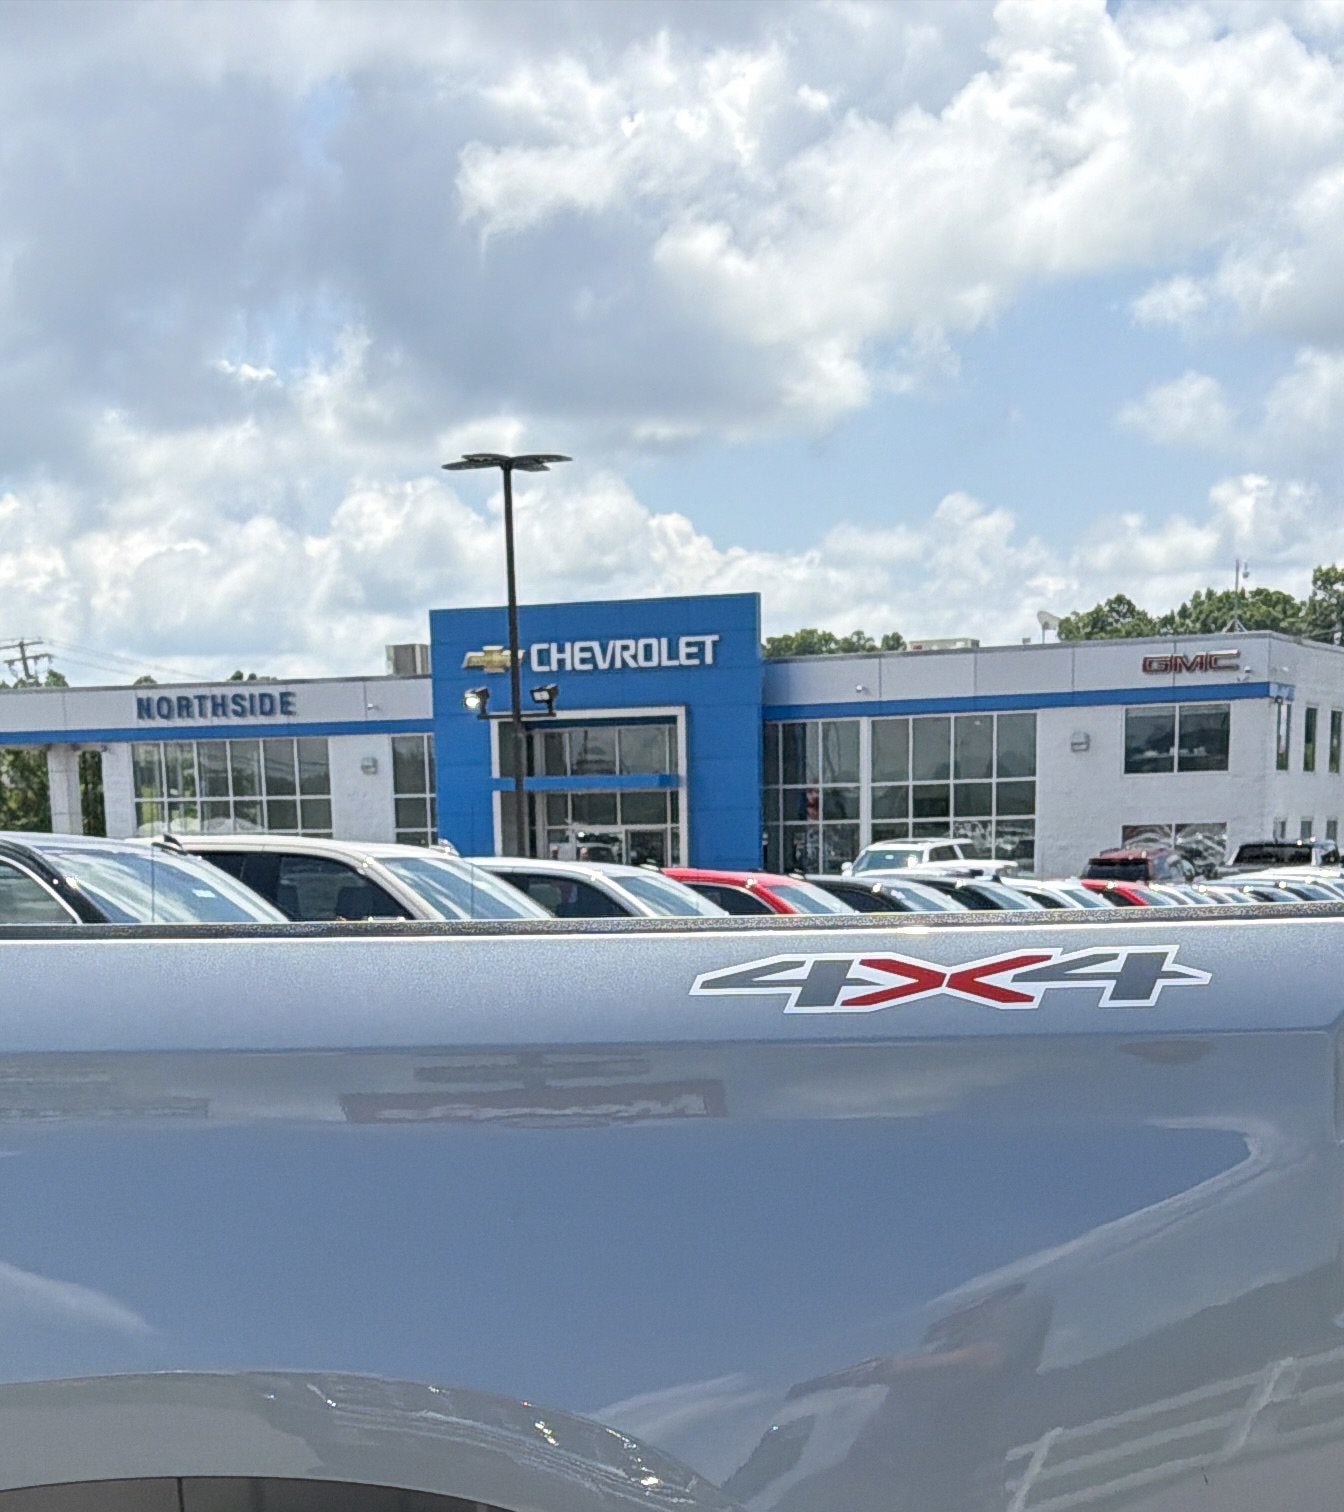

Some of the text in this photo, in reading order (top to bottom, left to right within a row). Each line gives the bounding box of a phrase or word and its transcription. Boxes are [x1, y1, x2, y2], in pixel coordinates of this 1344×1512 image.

[530, 634, 720, 673] CHEVROLET
[1142, 649, 1241, 674] GMC
[136, 691, 297, 721] NORTHSIDE
